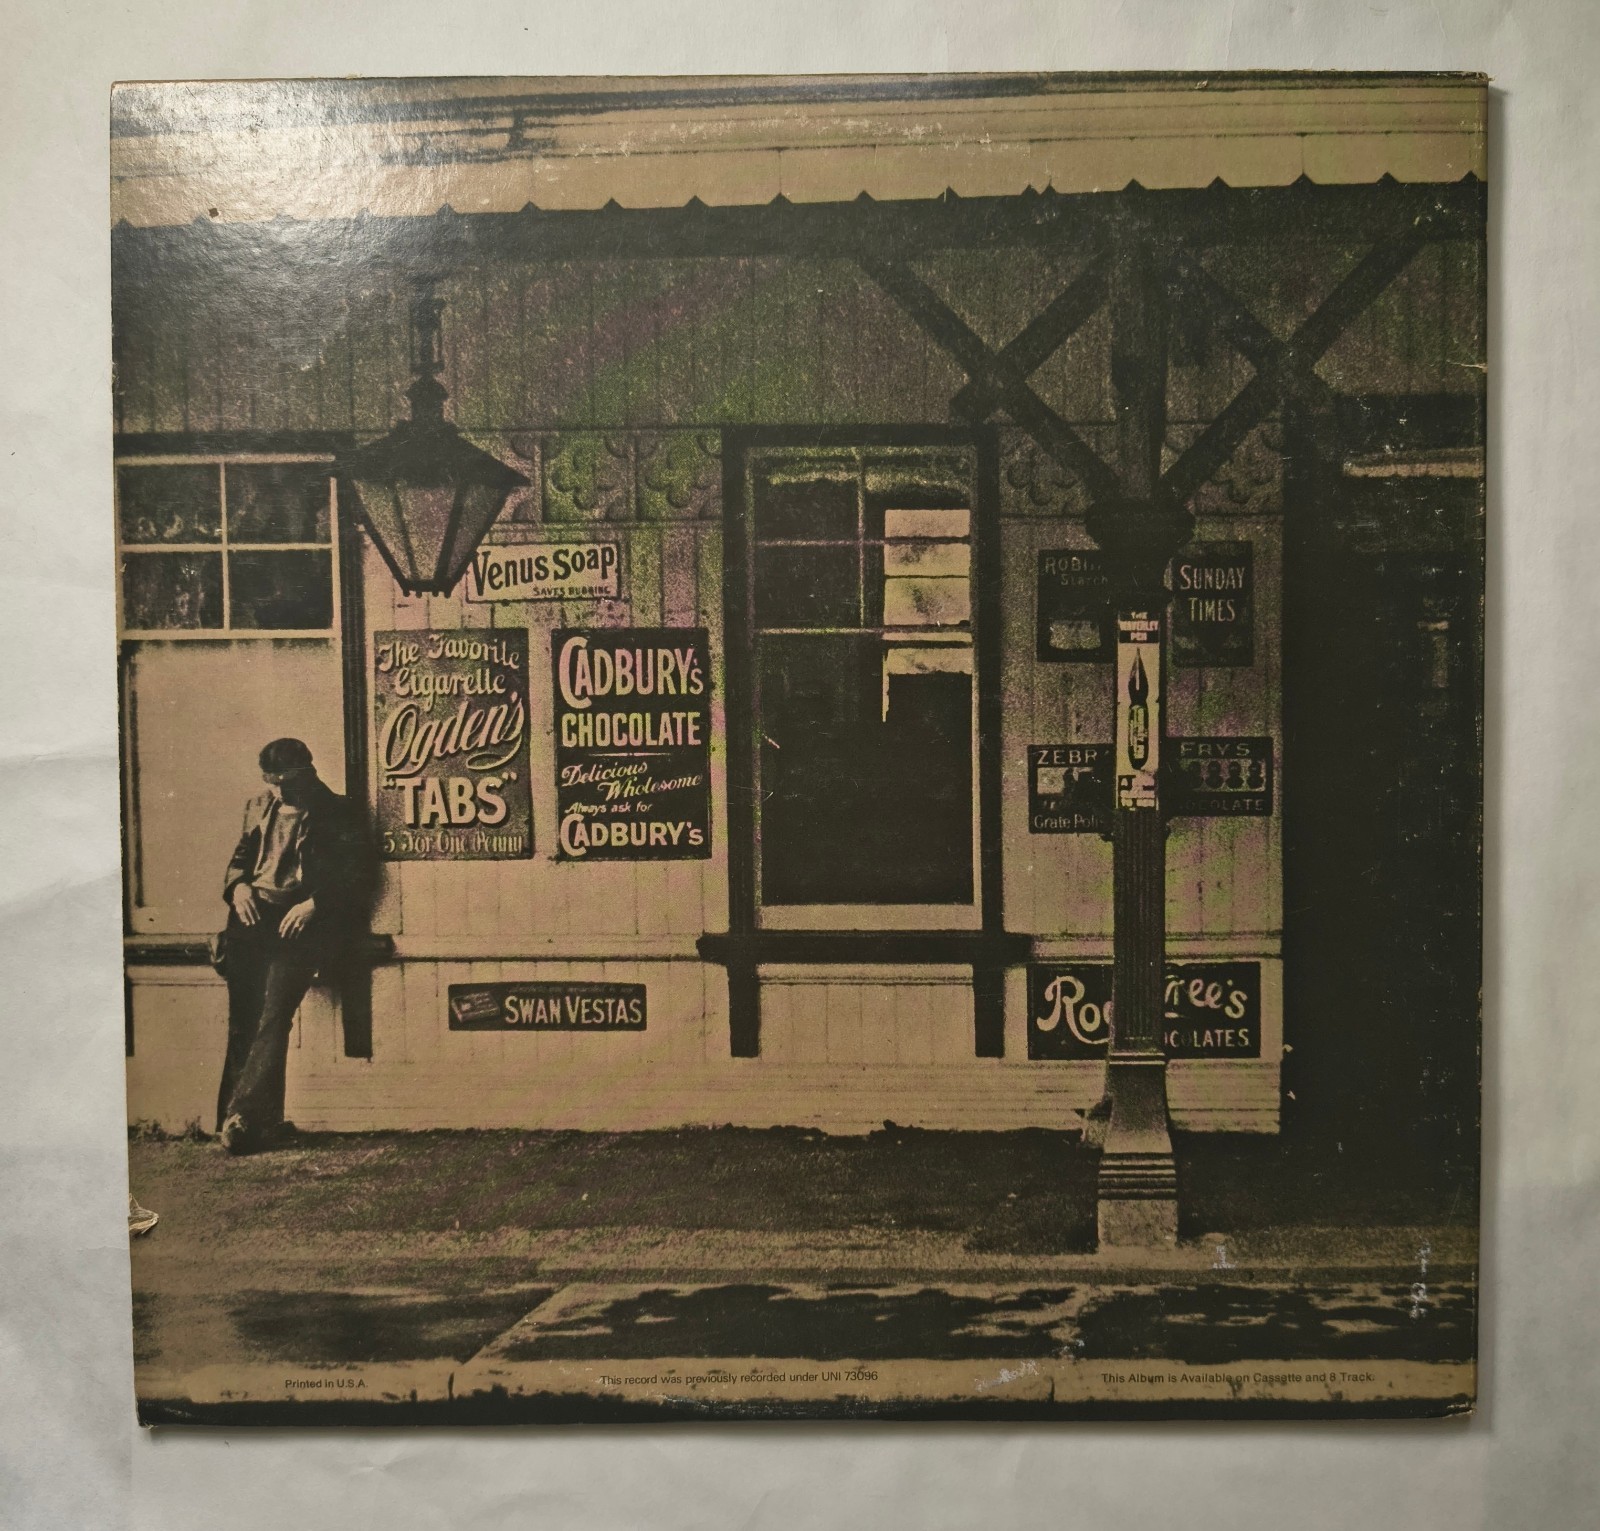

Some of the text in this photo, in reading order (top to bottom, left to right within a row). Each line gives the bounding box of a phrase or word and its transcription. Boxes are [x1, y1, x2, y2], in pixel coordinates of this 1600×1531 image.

[472, 546, 614, 596] Venus Soap
[1180, 564, 1246, 590] SUNDAY
[1188, 597, 1236, 622] TIMES
[378, 633, 520, 672] The Favorite
[559, 636, 704, 709] CADBURY's
[394, 667, 507, 713] Cigarette
[378, 691, 525, 776] Ogden's
[561, 712, 702, 748] CHOCOLATE
[1037, 749, 1098, 765] ZEBR
[561, 761, 648, 787] Delicious
[597, 774, 703, 801] Wholesome
[564, 801, 653, 816] Always ask for
[384, 830, 523, 854] 5 For One Penny
[560, 813, 704, 857] CADBURY's
[505, 995, 642, 1024] SWAN VESTAS
[285, 1379, 368, 1389] Printed in U.S.A.
[601, 1371, 878, 1385] This record was previously recorded under UNI 73096
[1101, 1373, 1125, 1383] This
[1128, 1373, 1164, 1383] Album
[1168, 1373, 1177, 1383] is
[1180, 1373, 1232, 1383] Available
[1235, 1375, 1250, 1383] on
[1253, 1373, 1301, 1383] Cassette
[1305, 1372, 1326, 1383] and
[1329, 1372, 1336, 1382] 8
